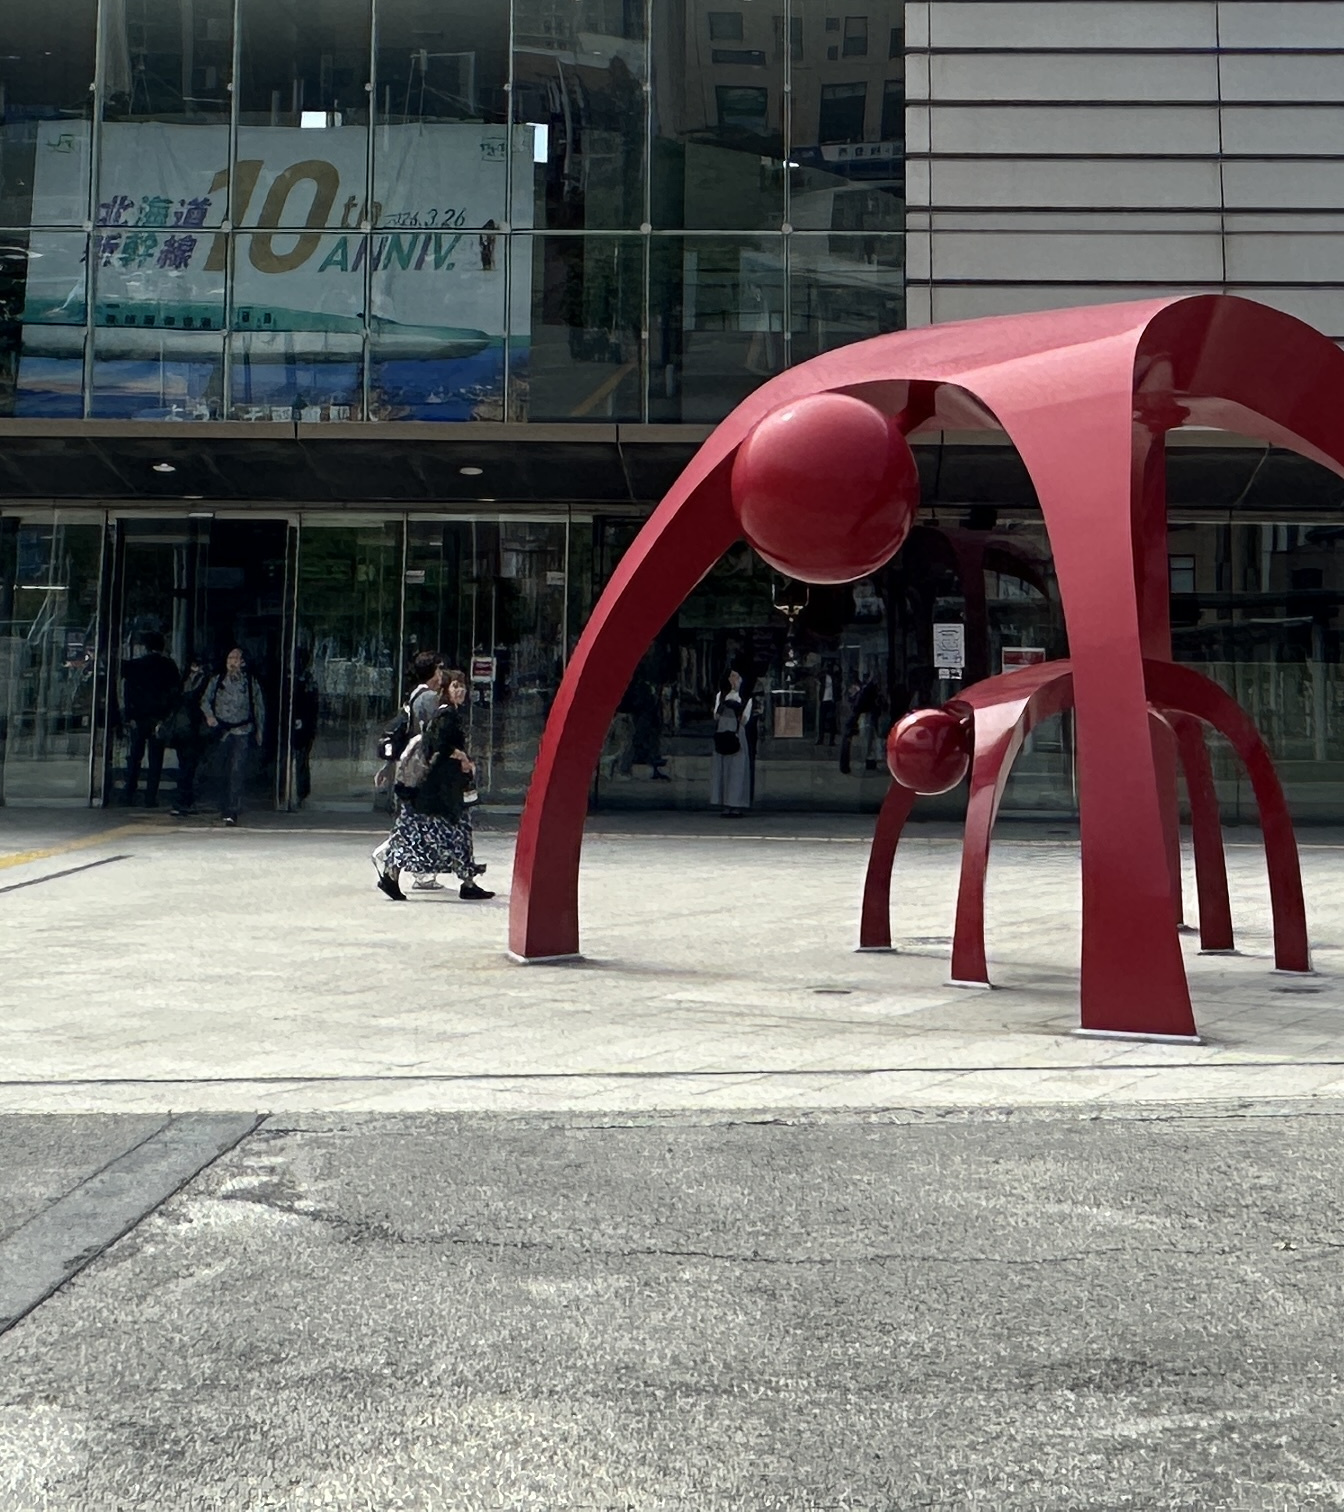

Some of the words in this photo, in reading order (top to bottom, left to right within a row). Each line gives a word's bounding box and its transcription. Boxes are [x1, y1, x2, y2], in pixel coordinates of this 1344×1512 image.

[98, 194, 212, 228] 北海道
[317, 235, 462, 273] ANNIV.
